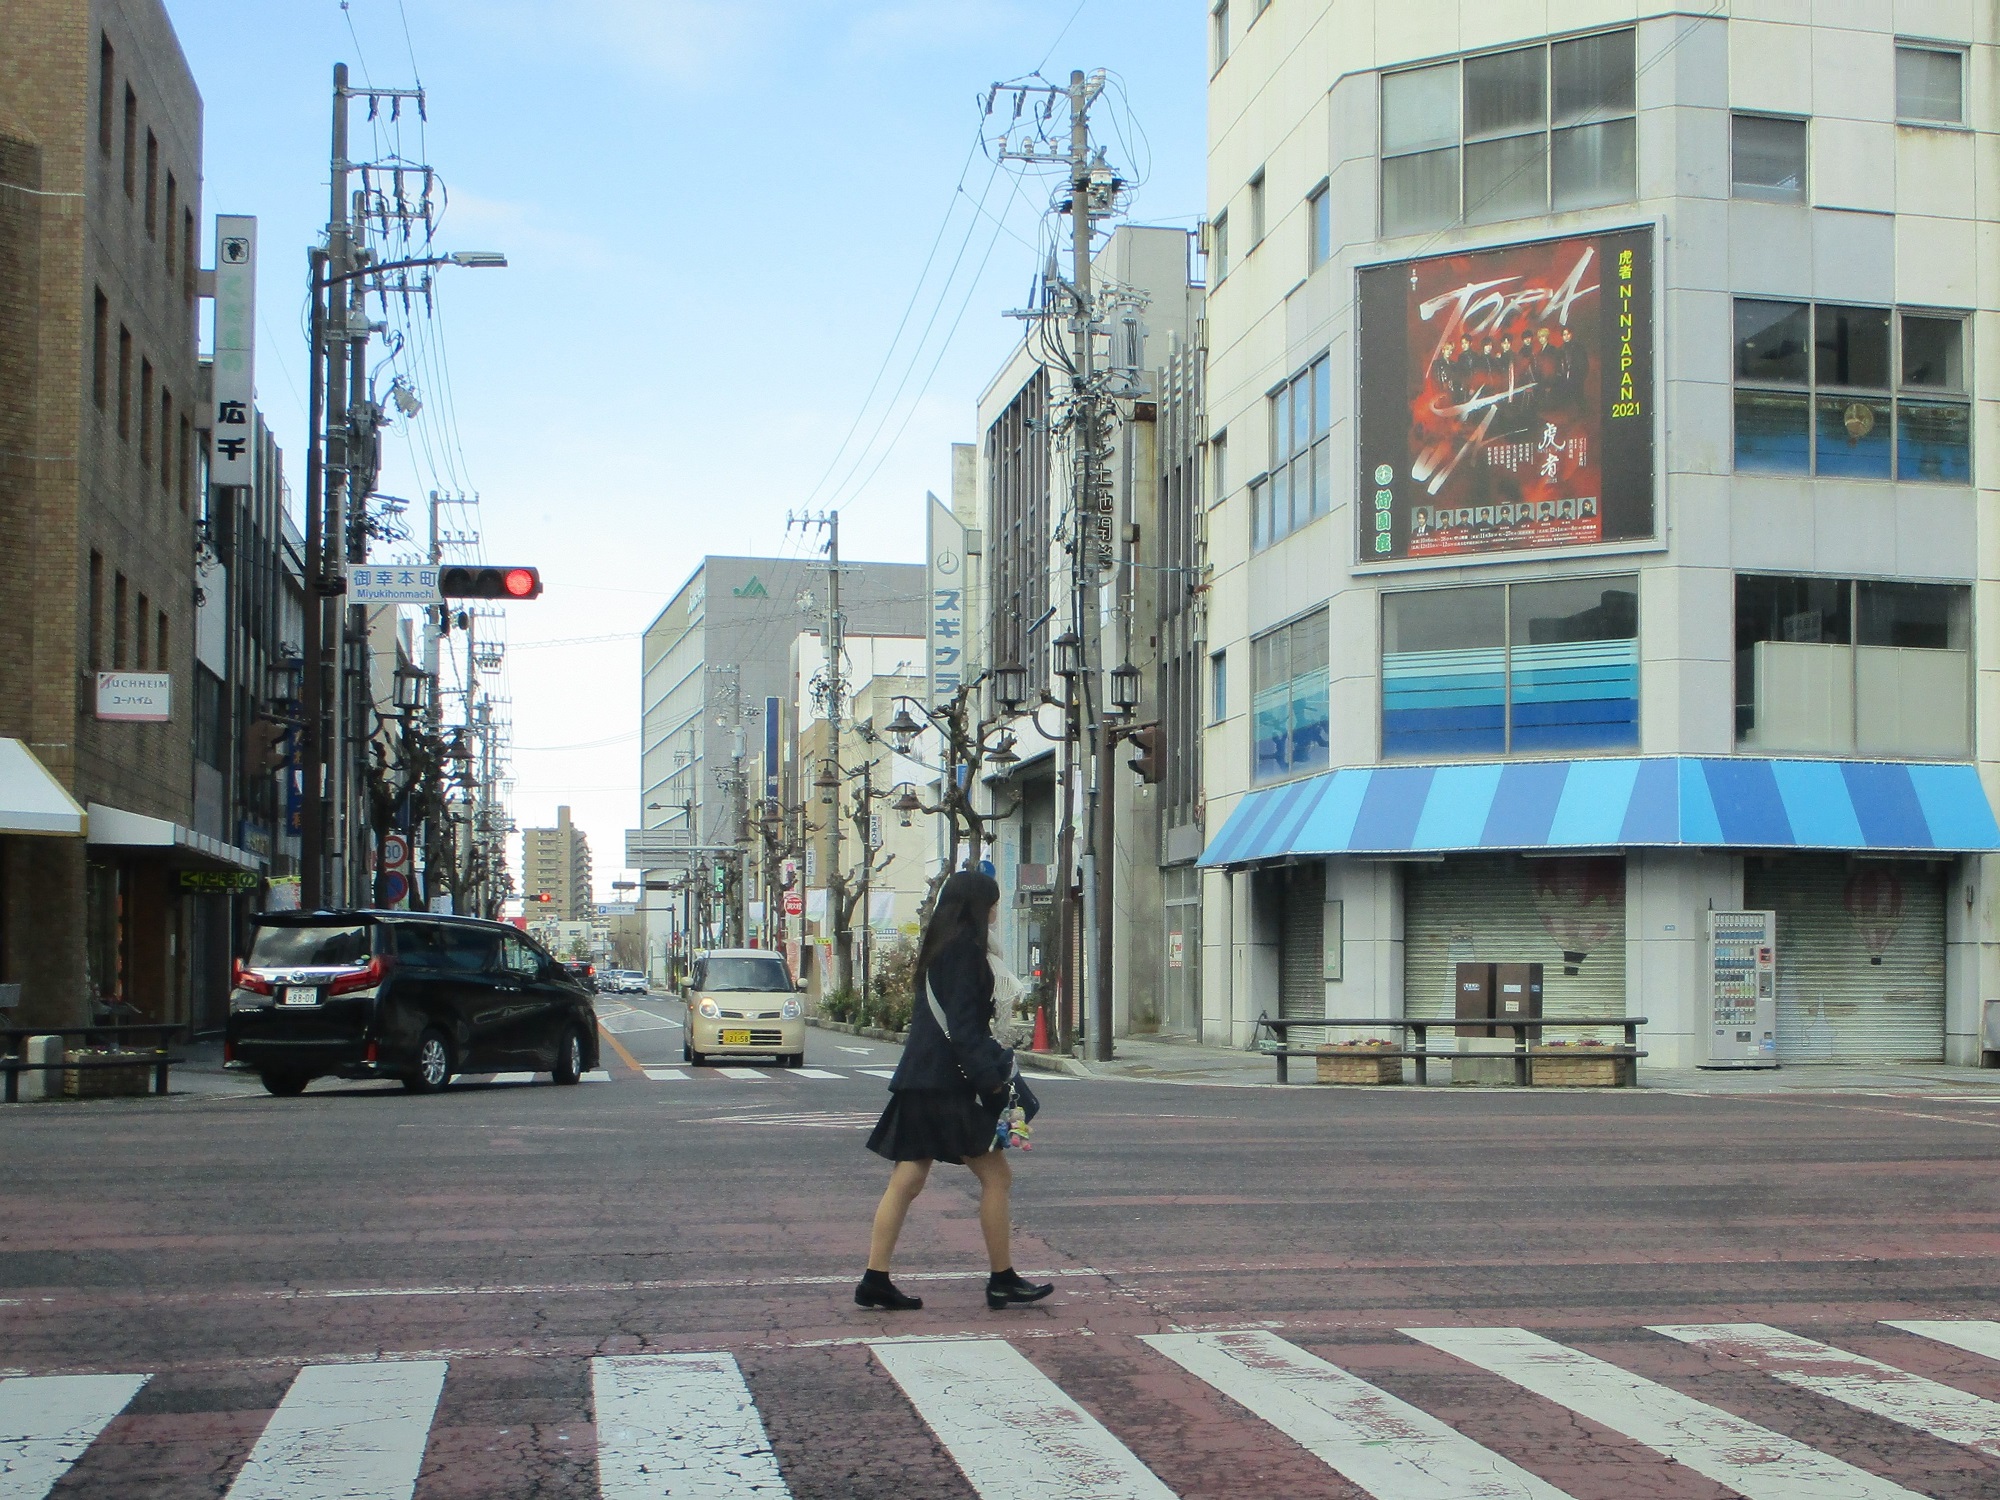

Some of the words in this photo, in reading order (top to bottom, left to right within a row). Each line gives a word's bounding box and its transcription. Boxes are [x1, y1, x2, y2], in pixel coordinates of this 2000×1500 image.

[1619, 250, 1633, 280] 虎者
[1620, 284, 1633, 401] NINJAPAN
[1612, 402, 1640, 418] 2021
[354, 570, 437, 587] 御幸本町
[357, 589, 434, 599] Miyukihonmachi
[935, 591, 961, 693] スギウラ
